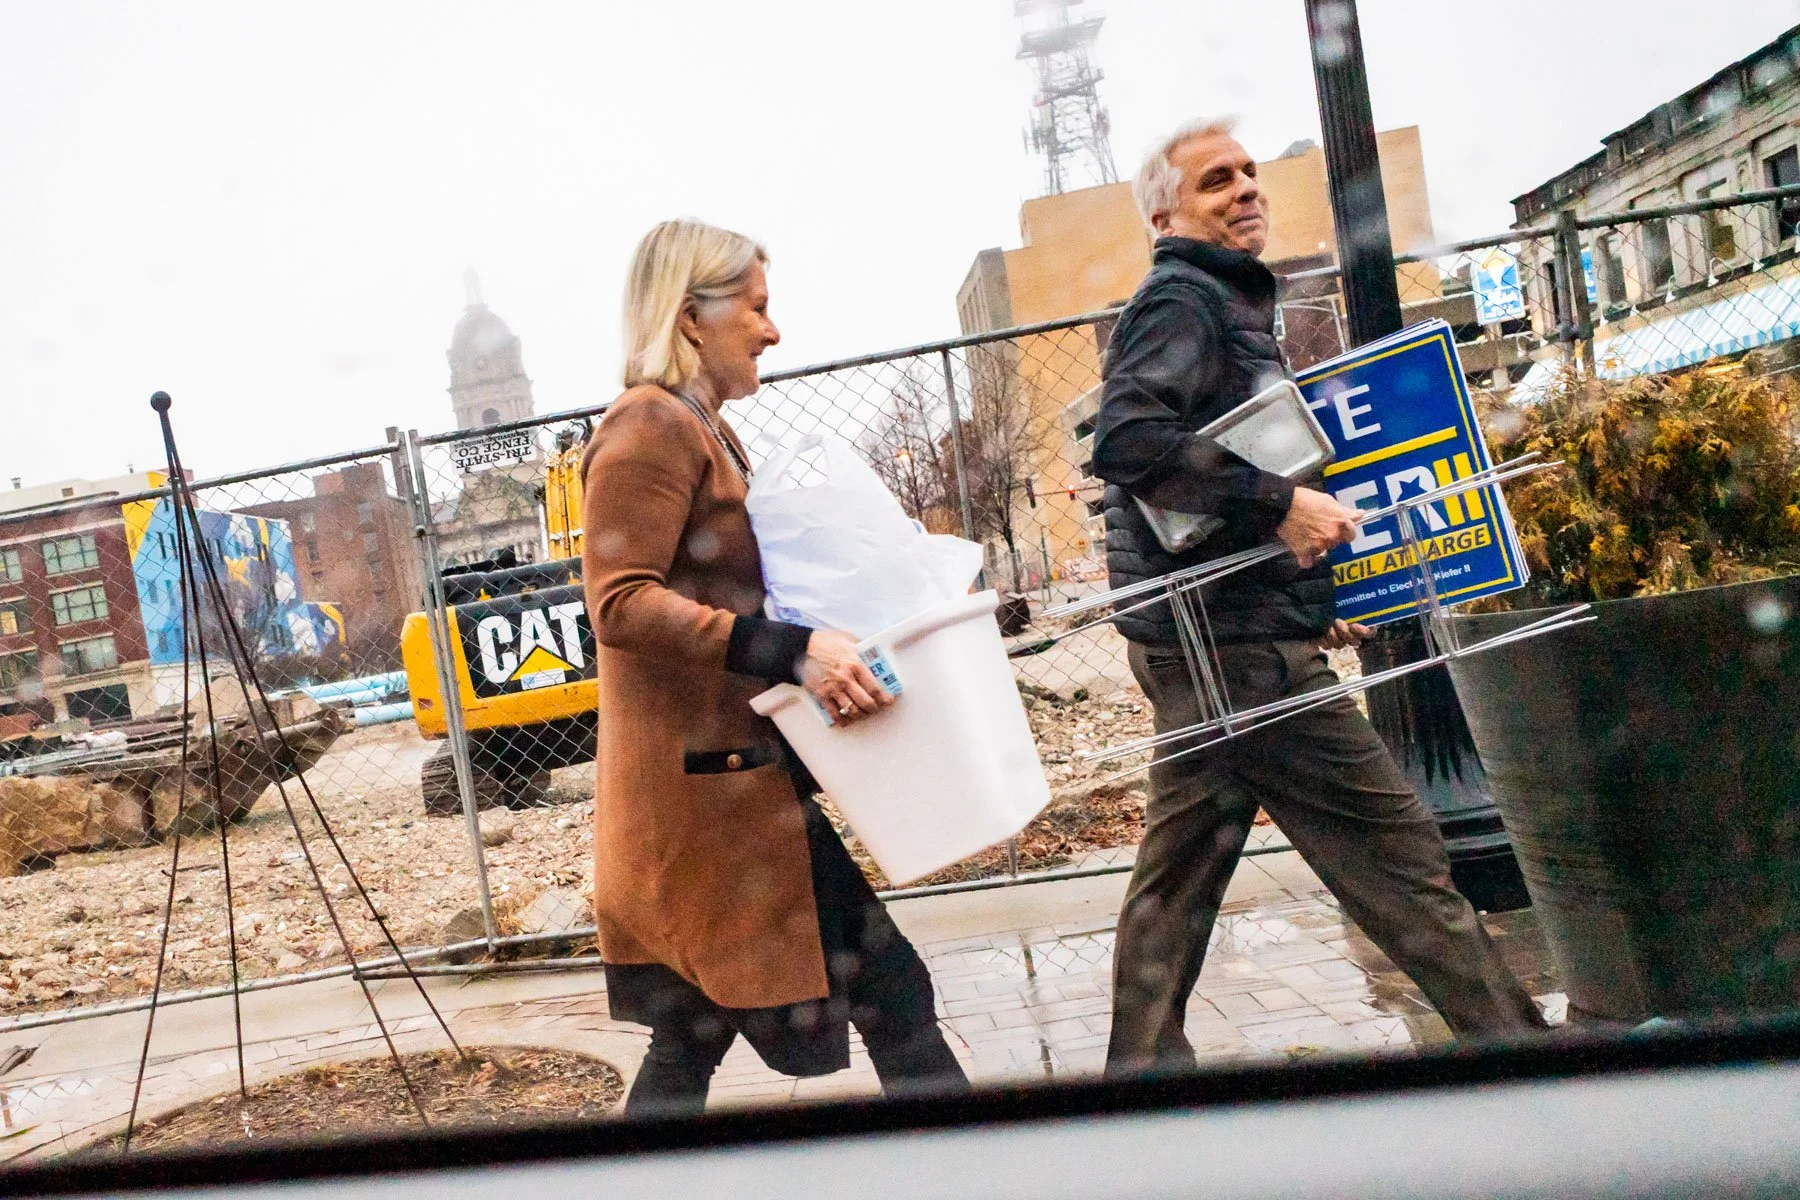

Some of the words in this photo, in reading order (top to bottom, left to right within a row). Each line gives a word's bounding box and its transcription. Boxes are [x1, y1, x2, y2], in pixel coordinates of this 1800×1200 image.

[455, 446, 479, 458] CO.
[456, 446, 531, 468] TRI-STATE
[483, 436, 530, 453] FENCE
[1419, 527, 1487, 559] ARGE
[1378, 586, 1389, 596] to
[1389, 580, 1414, 593] Elect
[1433, 568, 1463, 581] Kiefer
[477, 602, 585, 685] CAT
